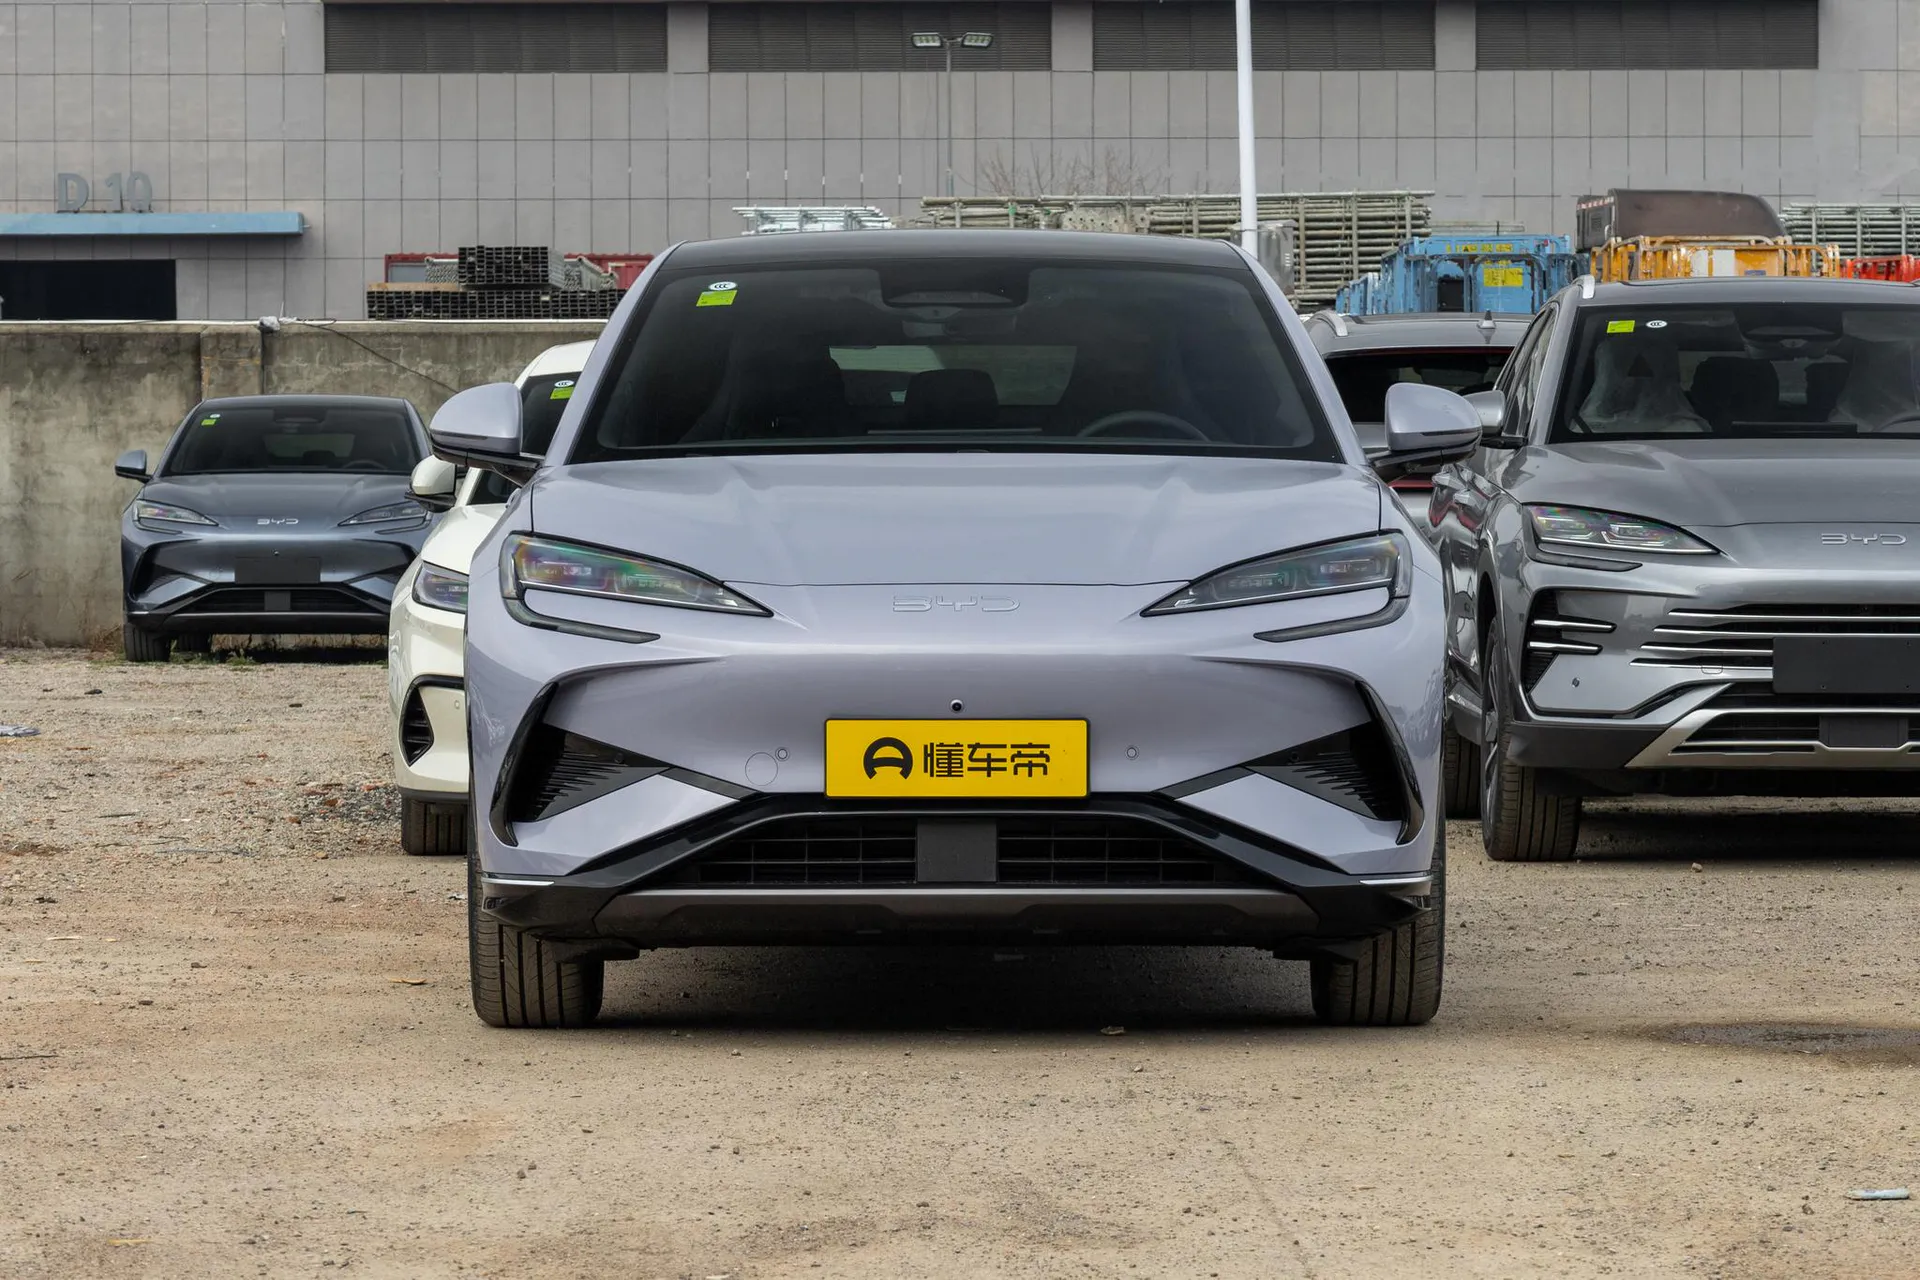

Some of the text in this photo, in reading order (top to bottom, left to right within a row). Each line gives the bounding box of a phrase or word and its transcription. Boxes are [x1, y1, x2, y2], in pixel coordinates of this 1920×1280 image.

[58, 171, 152, 212] D 10
[1821, 533, 1906, 545] BYD
[893, 595, 1020, 612] BYD
[924, 742, 1050, 777] 懂车帝
